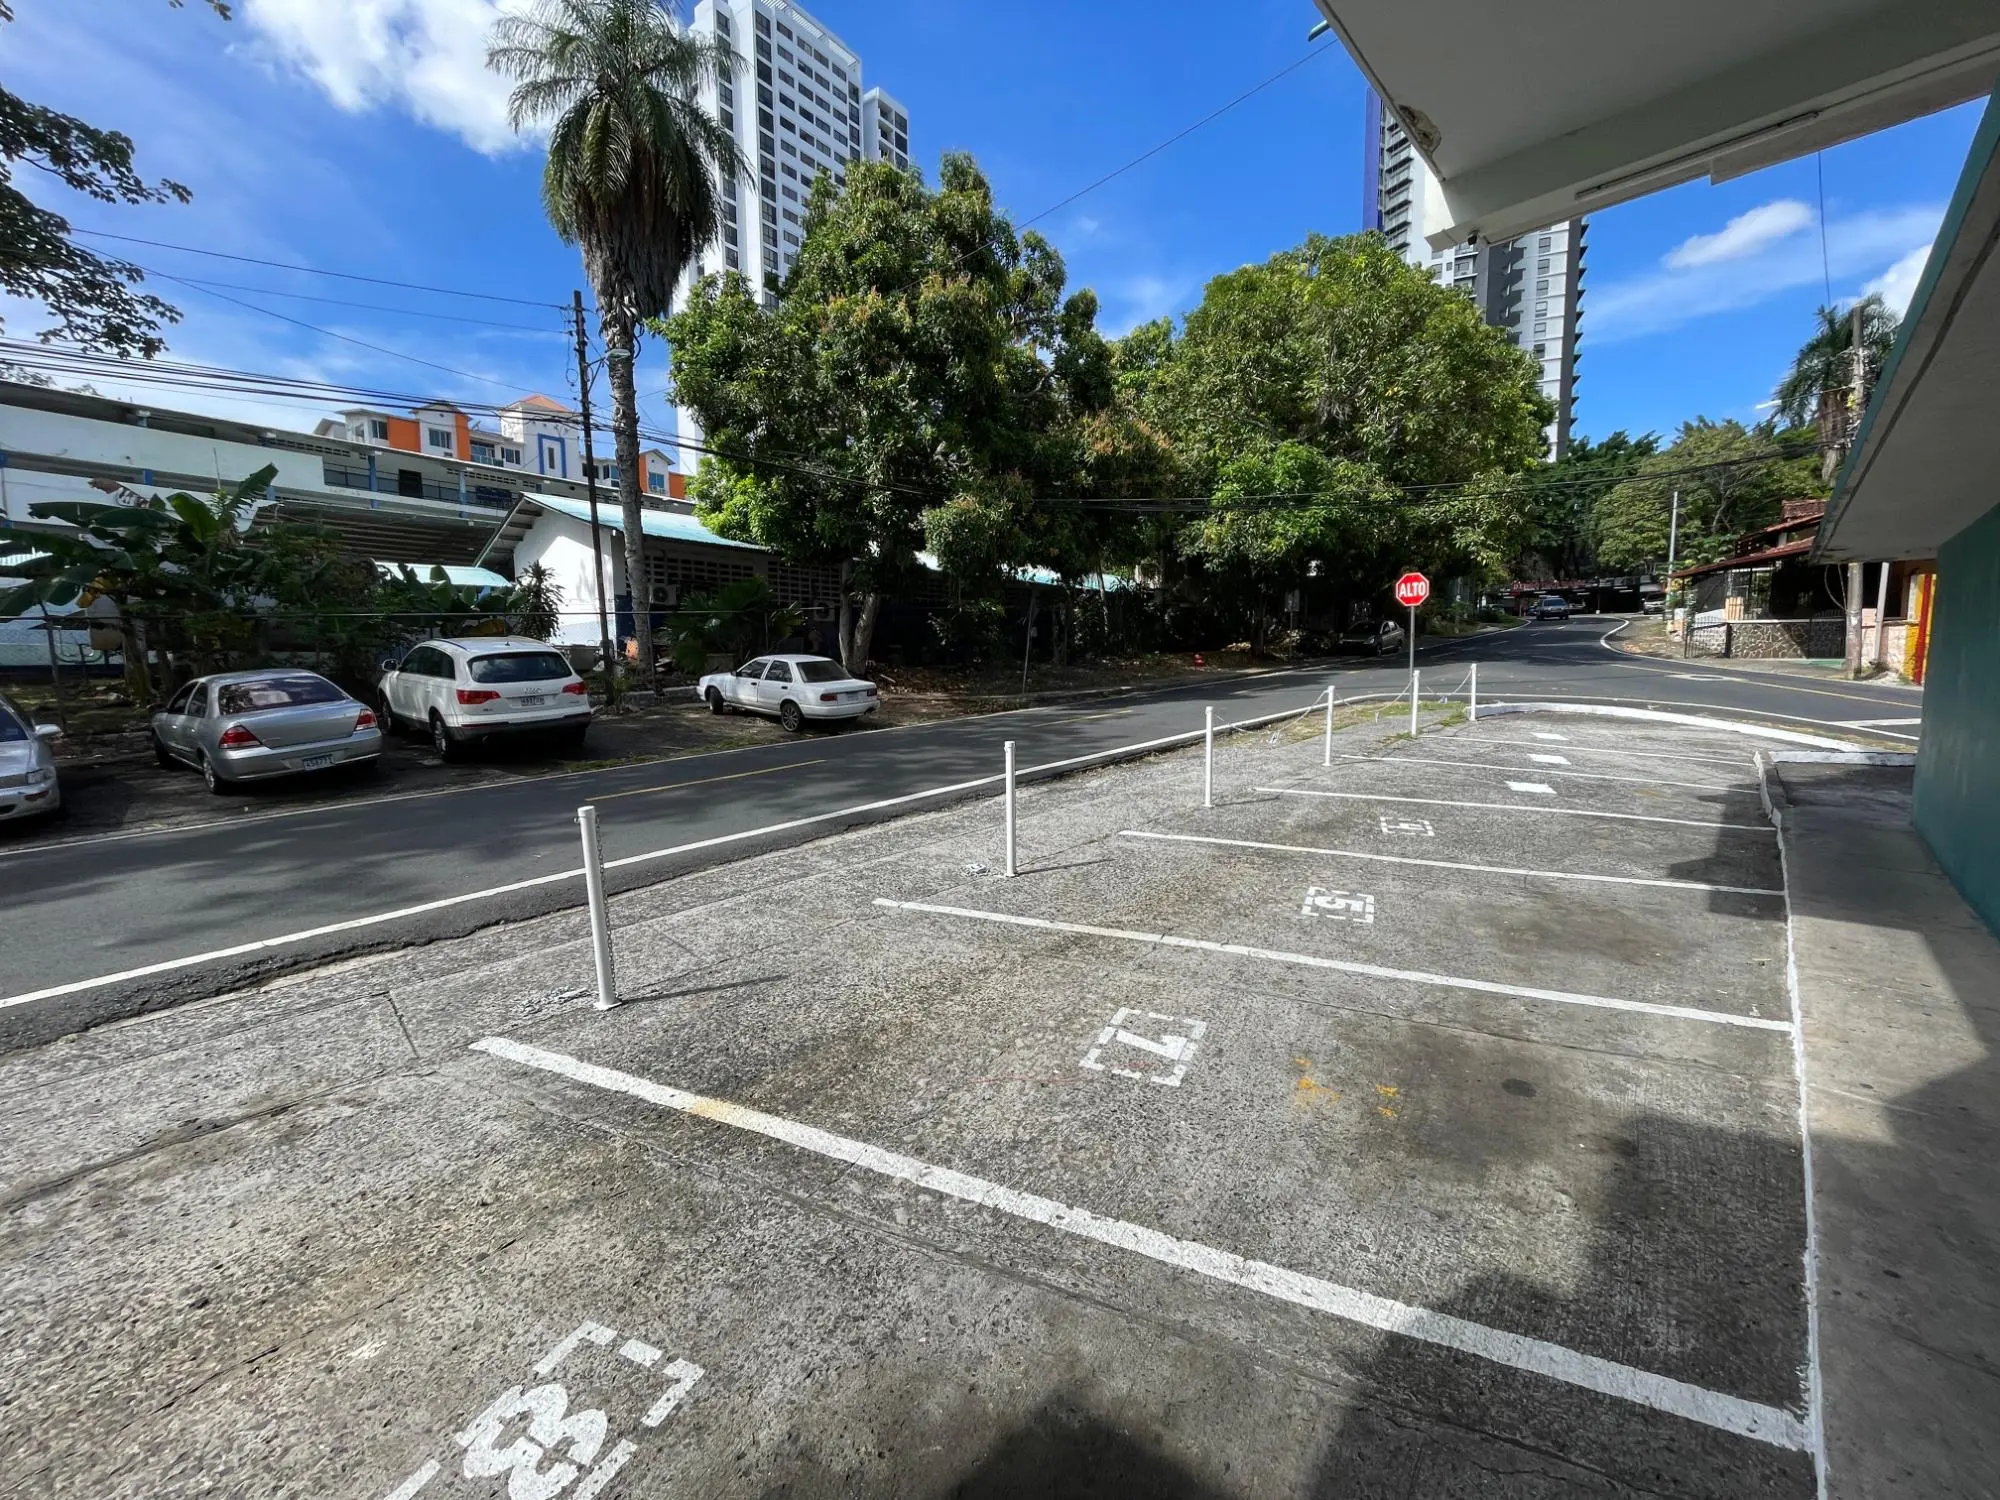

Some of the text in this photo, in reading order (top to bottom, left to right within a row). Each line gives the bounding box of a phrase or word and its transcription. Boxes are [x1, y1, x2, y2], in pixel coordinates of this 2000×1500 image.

[1398, 581, 1426, 597] ALTO
[1116, 1028, 1188, 1061] 7
[462, 1382, 608, 1500] 8
